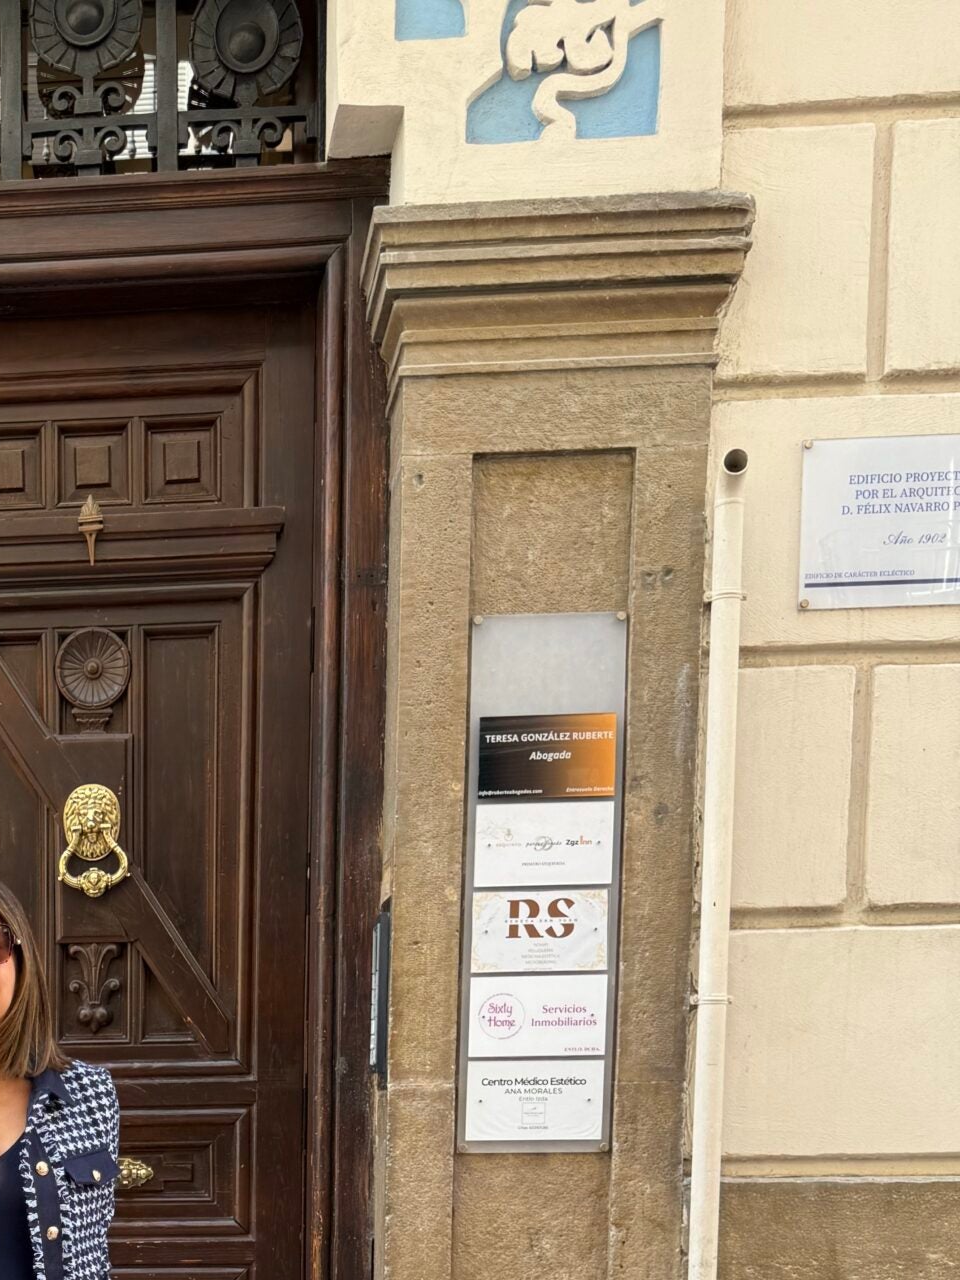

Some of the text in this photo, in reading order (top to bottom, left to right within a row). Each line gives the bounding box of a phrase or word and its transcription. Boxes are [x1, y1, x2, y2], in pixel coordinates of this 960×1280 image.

[849, 473, 902, 485] EDIFICIO
[855, 489, 879, 500] POR
[882, 488, 897, 499] EL
[841, 505, 853, 515] D.
[856, 502, 892, 515] FÉLIX
[894, 501, 950, 513] NAVARRO
[883, 531, 947, 545] Año 1902
[804, 572, 834, 580] EDIFICIO
[844, 570, 878, 579] CARÁCTER
[879, 569, 915, 577] ECLÉCTICO
[485, 730, 614, 744] TERESA GONZÁLEZ RUBERTE
[529, 750, 572, 762] Abogada
[505, 897, 576, 939] RS
[542, 1003, 587, 1014] Servicios
[487, 1016, 516, 1031] Home
[531, 1017, 597, 1027] Inmobiliarios
[481, 1076, 587, 1086] Centro Médico Estético
[524, 1087, 563, 1095] MORALES
